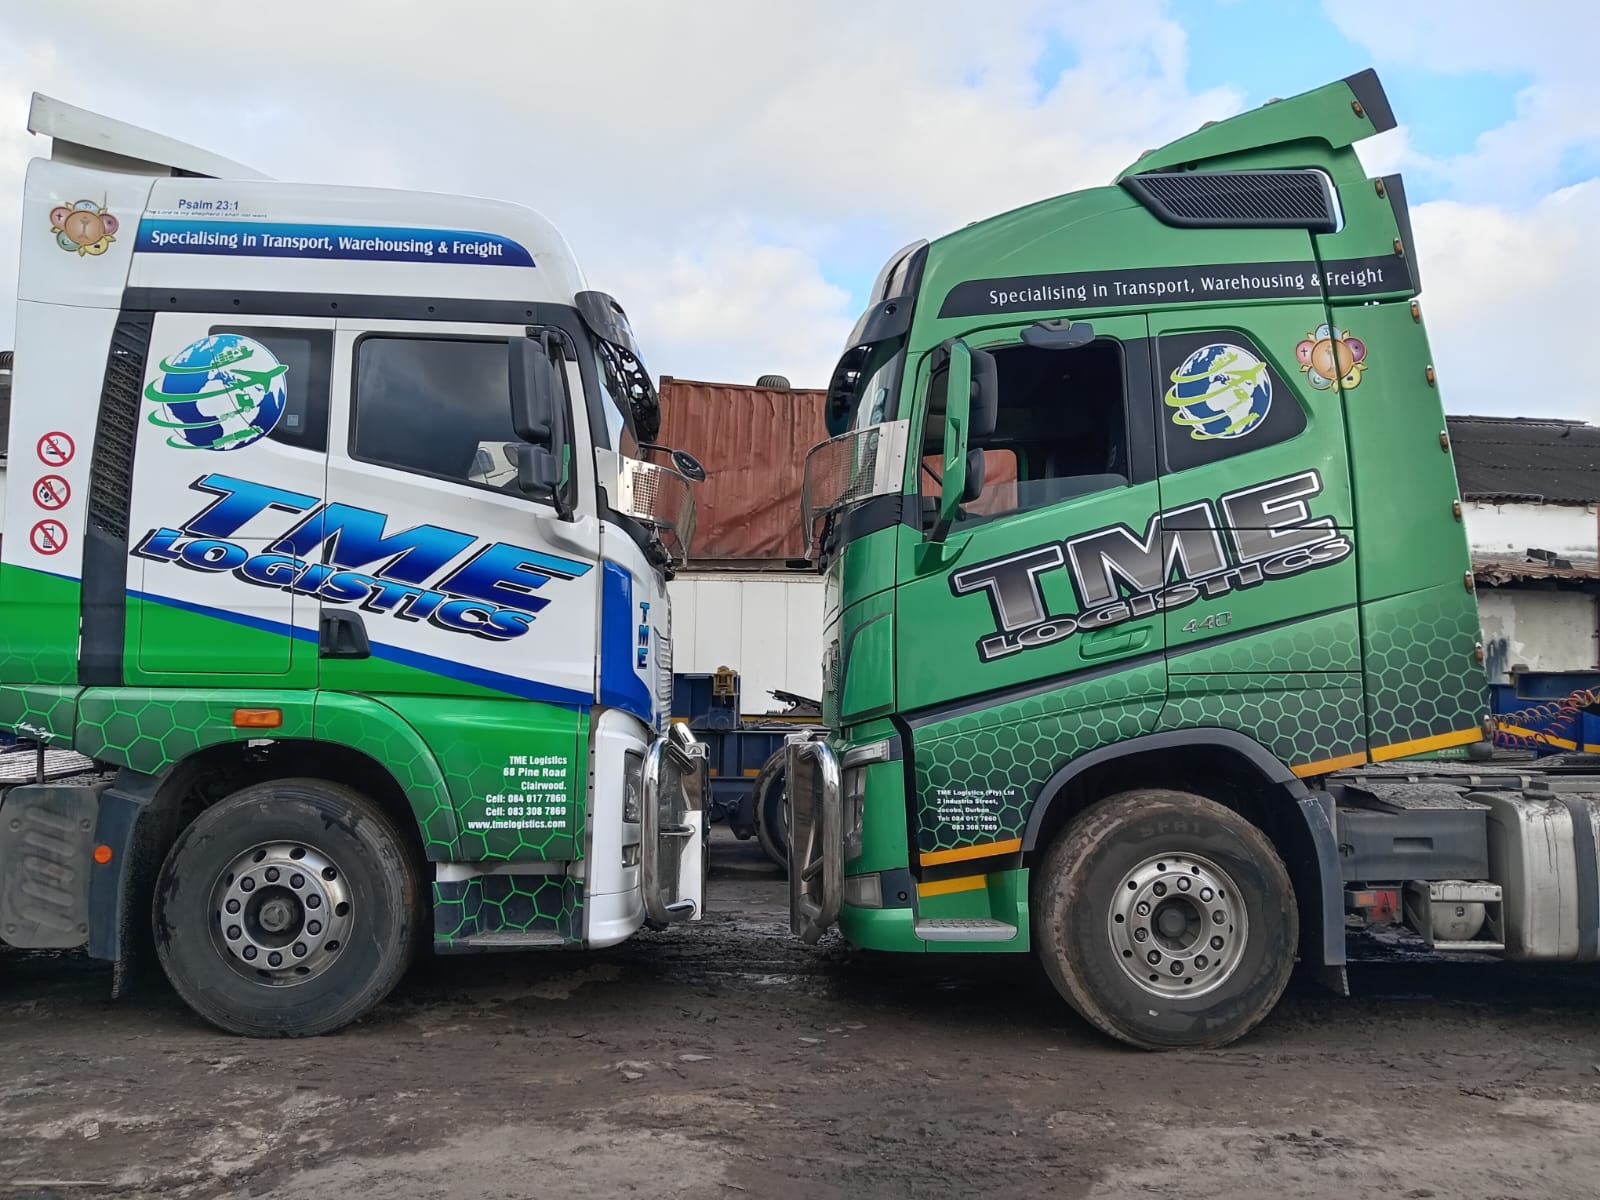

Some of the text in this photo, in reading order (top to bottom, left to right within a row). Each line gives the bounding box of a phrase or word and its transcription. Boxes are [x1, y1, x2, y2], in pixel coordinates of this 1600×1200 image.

[178, 199, 239, 211] Psalm 23:1
[151, 230, 503, 258] Specialising in Transport, Warehousing & Freight
[989, 268, 1384, 306] Specialising in Transport, Warehousing & Freight
[183, 472, 594, 614] TME
[950, 470, 1337, 632] TME
[129, 527, 536, 642] LOGISTICS
[976, 535, 1354, 663] LOGISTICS
[1181, 611, 1233, 633] 440
[636, 601, 651, 670] TME
[509, 755, 568, 766] TME Logistics
[518, 767, 540, 777] Pine
[542, 767, 567, 777] Road
[521, 781, 567, 791] Clairwood.
[953, 789, 985, 797] Logistics
[985, 789, 1002, 797] (Pty)
[485, 794, 567, 804] Cell: 084 017 7860
[974, 798, 999, 806] Street,
[485, 806, 506, 817] Cell:
[507, 807, 525, 817] 083
[544, 807, 567, 817] 7869
[467, 820, 566, 829] www.tmelogistics.com
[937, 815, 950, 823] Tel:
[965, 815, 979, 823] 017
[980, 815, 997, 823] 7860
